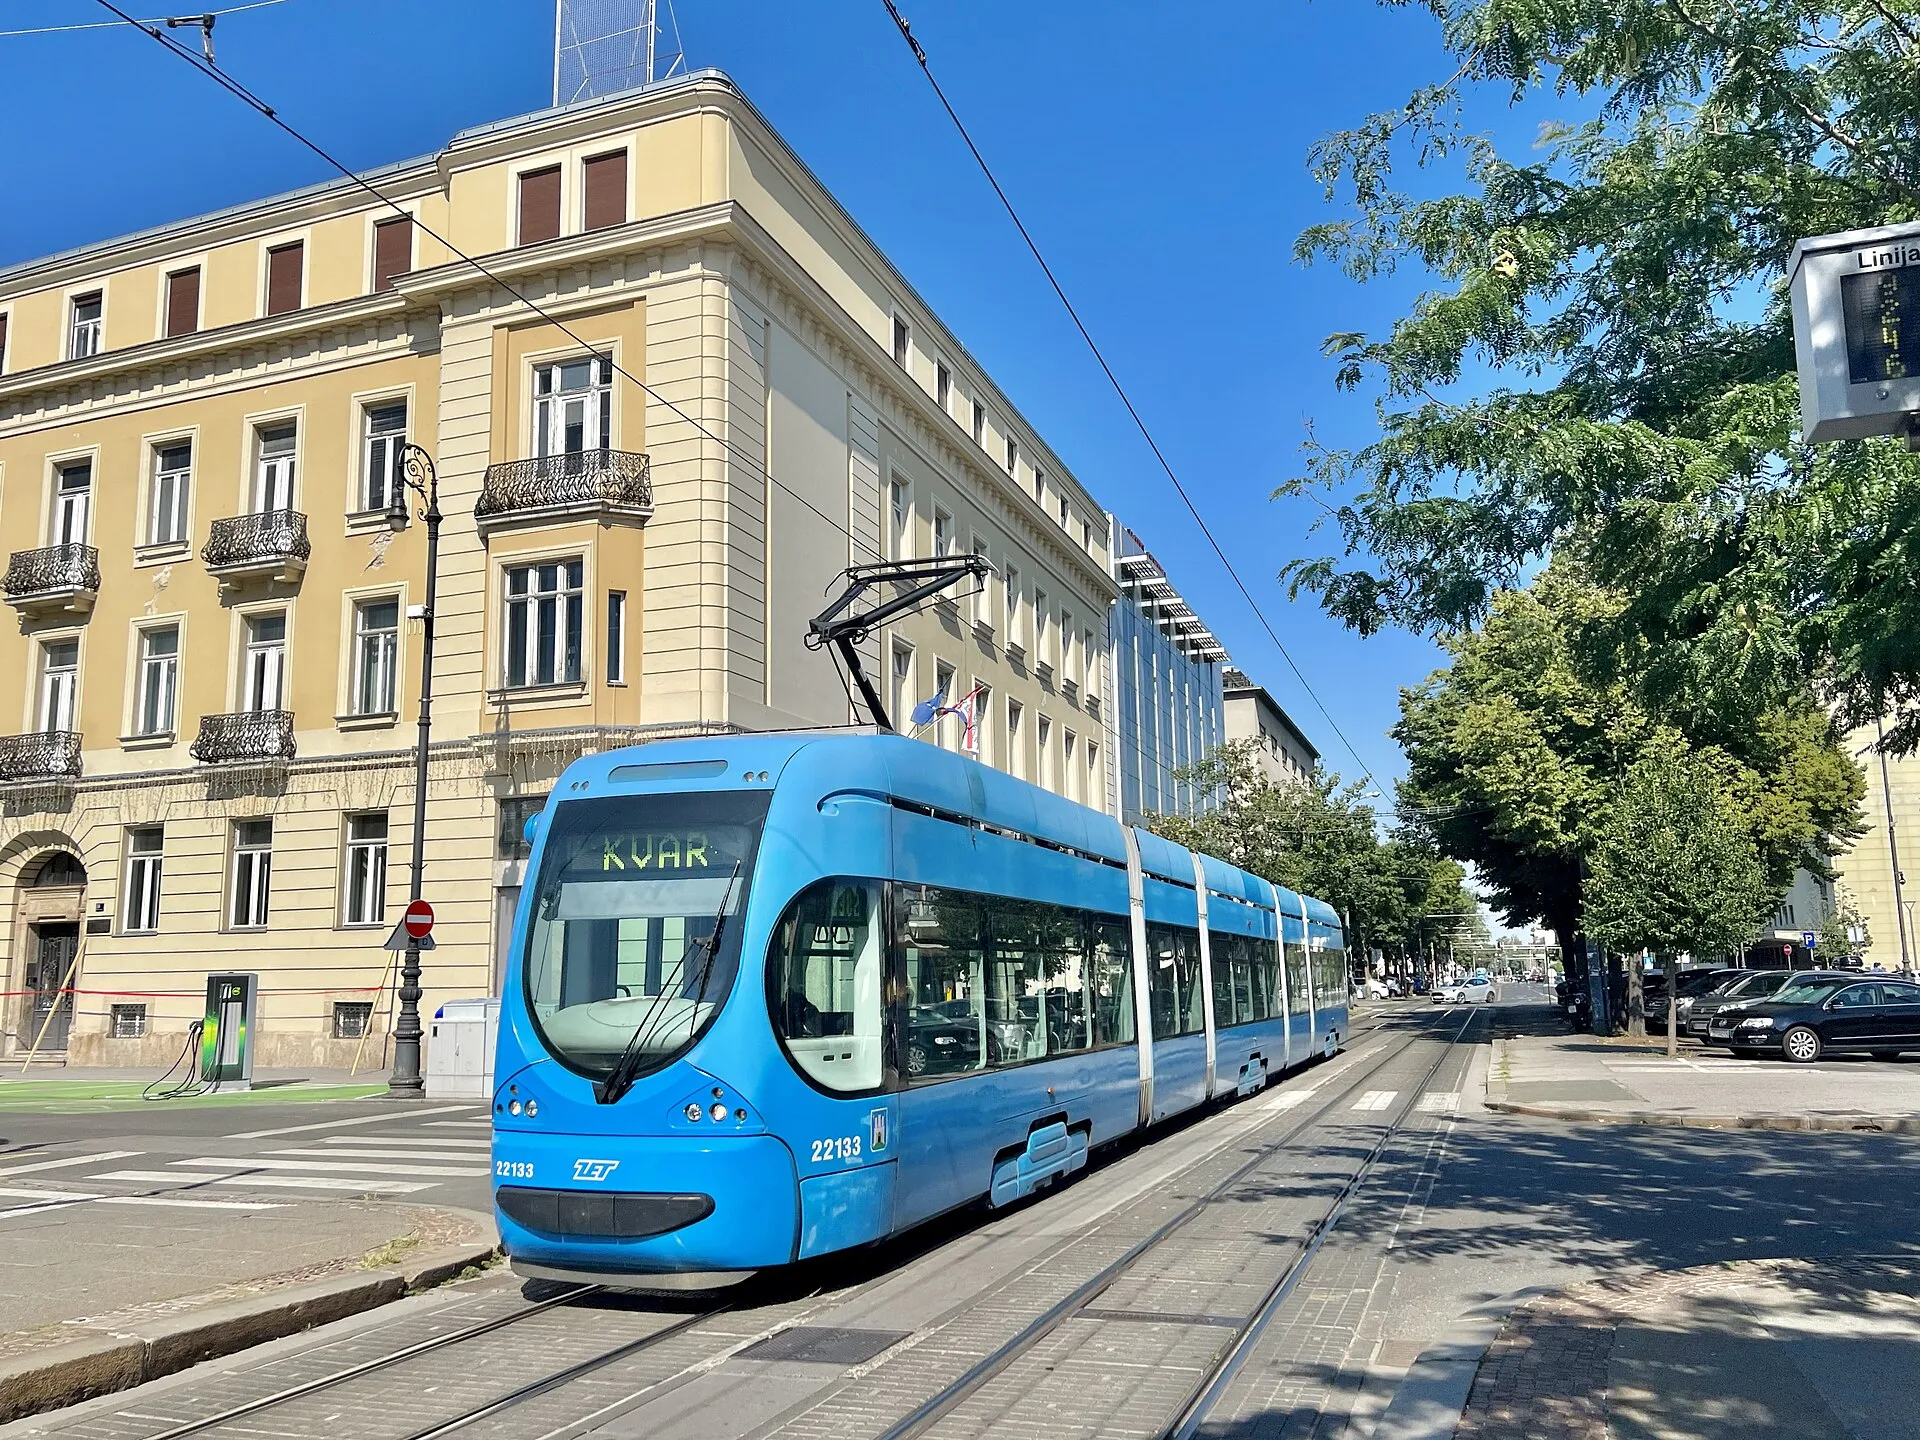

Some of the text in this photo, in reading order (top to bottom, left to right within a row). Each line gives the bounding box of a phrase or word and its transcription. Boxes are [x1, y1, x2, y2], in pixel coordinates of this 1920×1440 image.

[1882, 327, 1899, 350] 4
[1885, 353, 1906, 378] 6
[603, 833, 709, 871] KVAR
[811, 1135, 861, 1163] 22133
[496, 1161, 534, 1178] 22133
[573, 1159, 620, 1181] ZET
